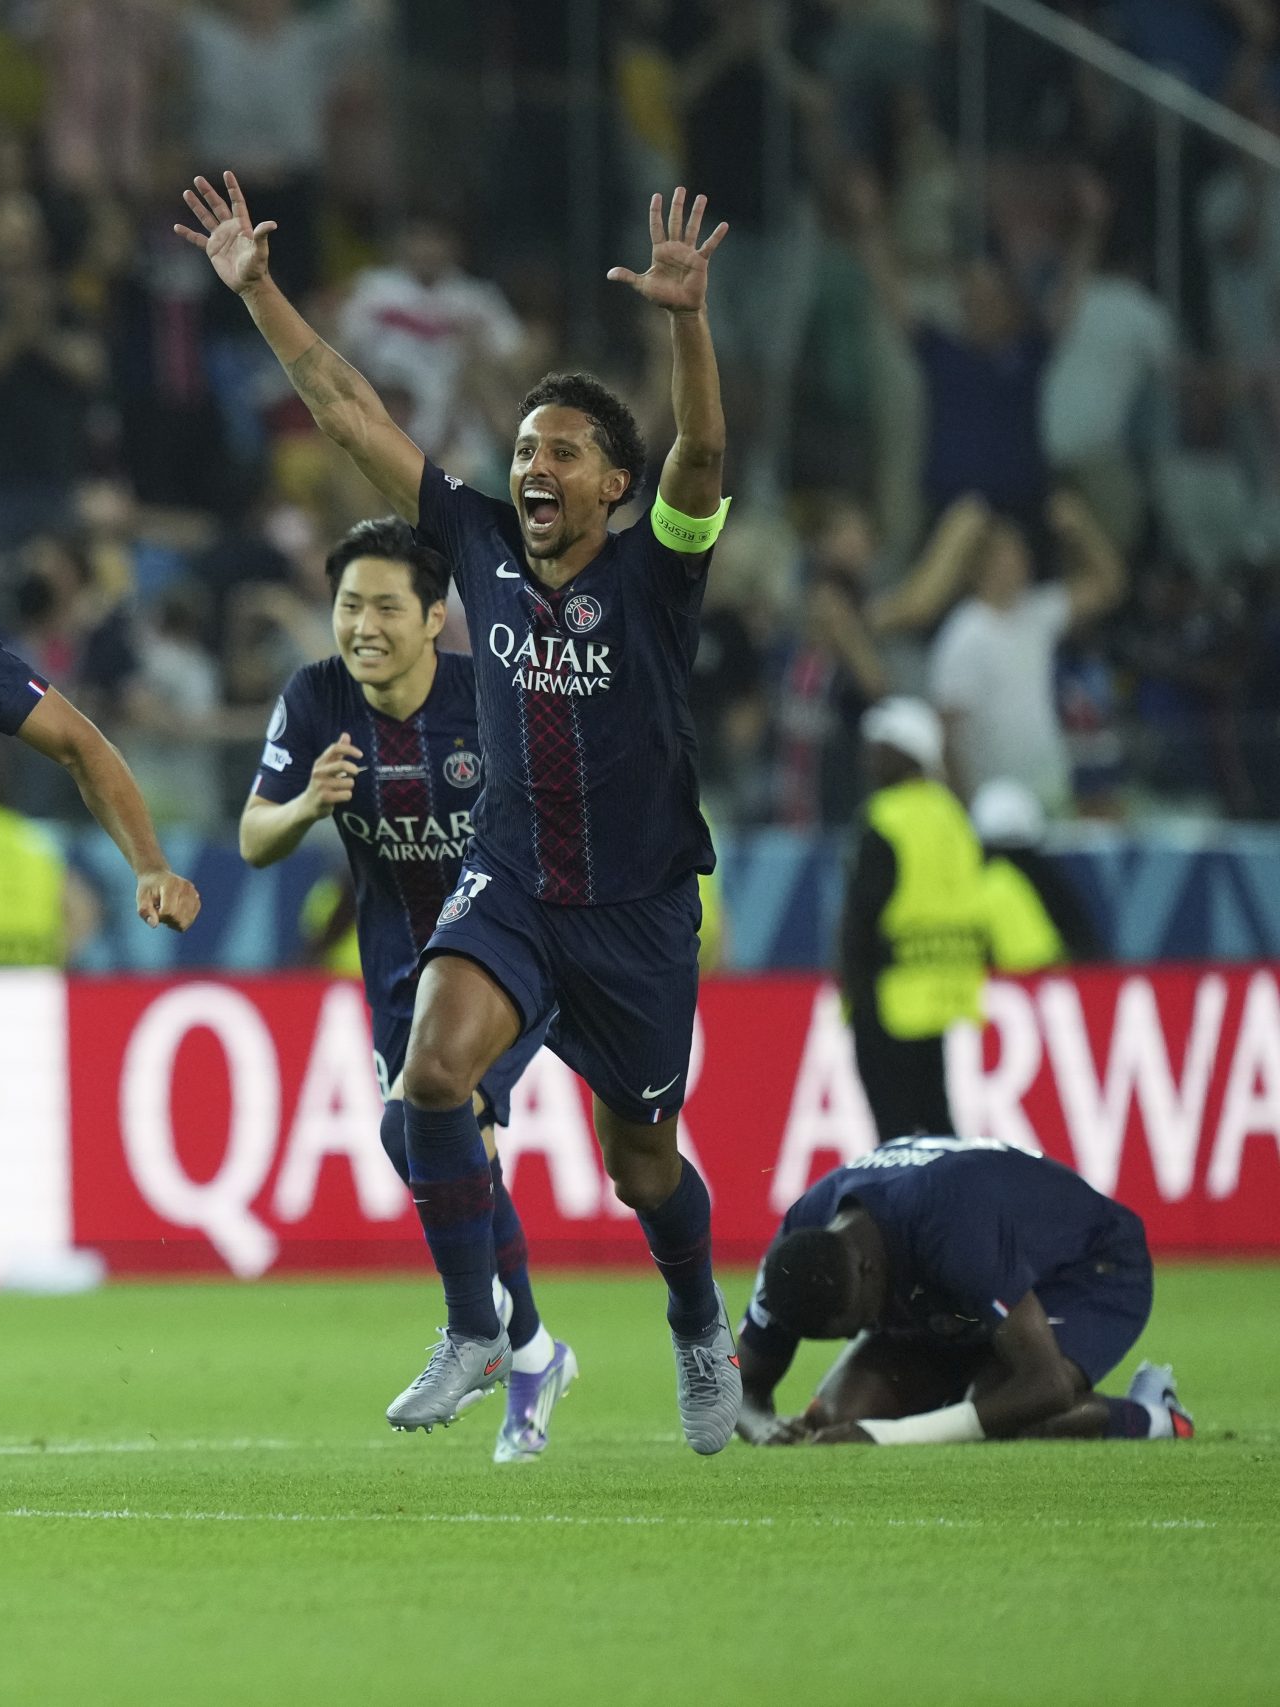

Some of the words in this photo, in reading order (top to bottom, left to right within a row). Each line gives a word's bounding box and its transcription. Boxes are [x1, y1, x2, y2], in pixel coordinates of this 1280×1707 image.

[656, 513, 694, 541] RESPEC
[567, 597, 588, 614] PARIS
[489, 623, 612, 674] QATAR
[511, 668, 610, 696] AIRWAYS
[341, 811, 475, 845] QATAR
[379, 838, 465, 861] AIRWAY
[120, 982, 713, 1279] QAA
[770, 968, 1280, 1216] ARWA
